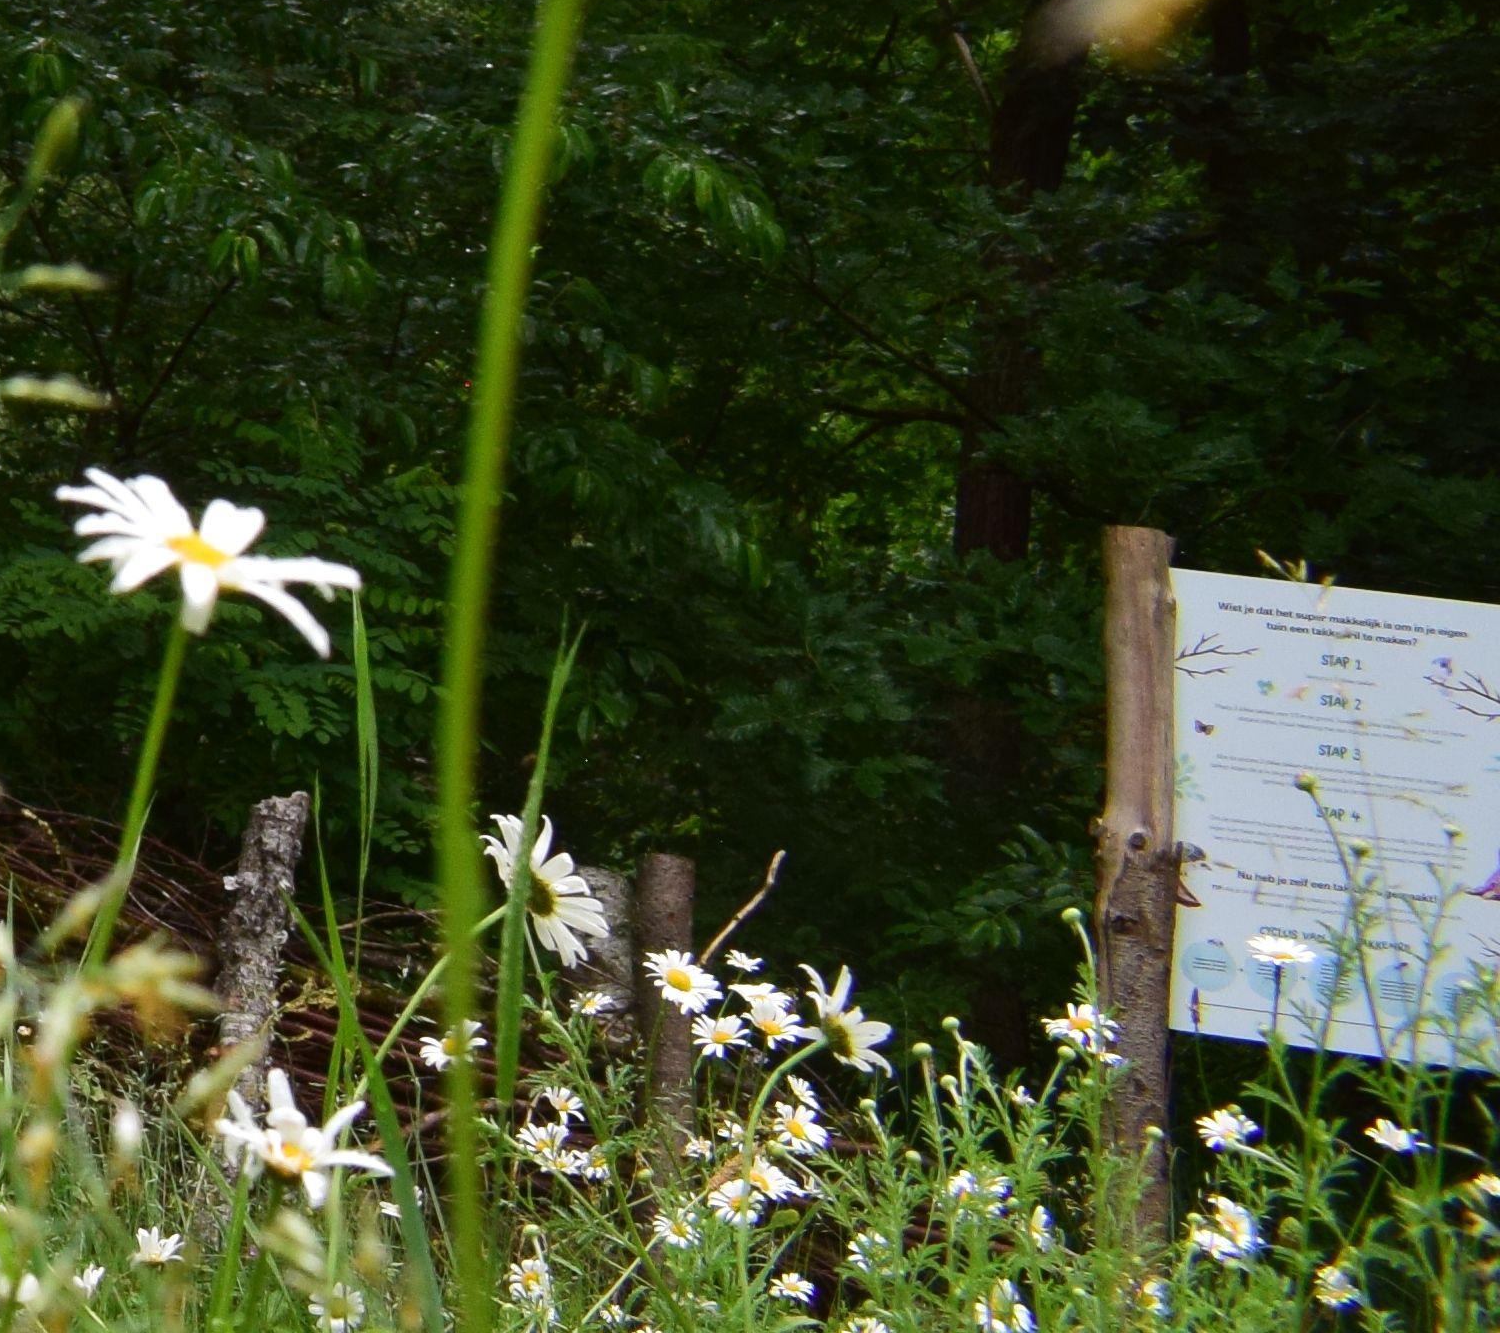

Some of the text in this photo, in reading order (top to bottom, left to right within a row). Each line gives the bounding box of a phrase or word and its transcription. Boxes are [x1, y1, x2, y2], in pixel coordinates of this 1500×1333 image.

[1218, 601, 1242, 613] Wist
[1244, 604, 1254, 615] je
[1256, 606, 1273, 616] dat
[1276, 608, 1293, 618] het
[1295, 611, 1326, 622] super
[1329, 615, 1381, 629] makkelijk
[1394, 623, 1412, 632] om
[1426, 625, 1436, 636] je
[1438, 627, 1468, 639] eigen
[1265, 621, 1287, 632] tuin
[1289, 625, 1309, 634] een
[1362, 632, 1373, 642] te
[1375, 634, 1418, 647] maken?
[1321, 654, 1362, 670] STAP 1
[1354, 698, 1362, 711] 2
[1318, 744, 1361, 761] STAP 3
[1351, 810, 1361, 822] 4
[1237, 870, 1253, 881] Nu
[1254, 873, 1275, 884] heb
[1277, 876, 1287, 886] je
[1310, 881, 1331, 890] een
